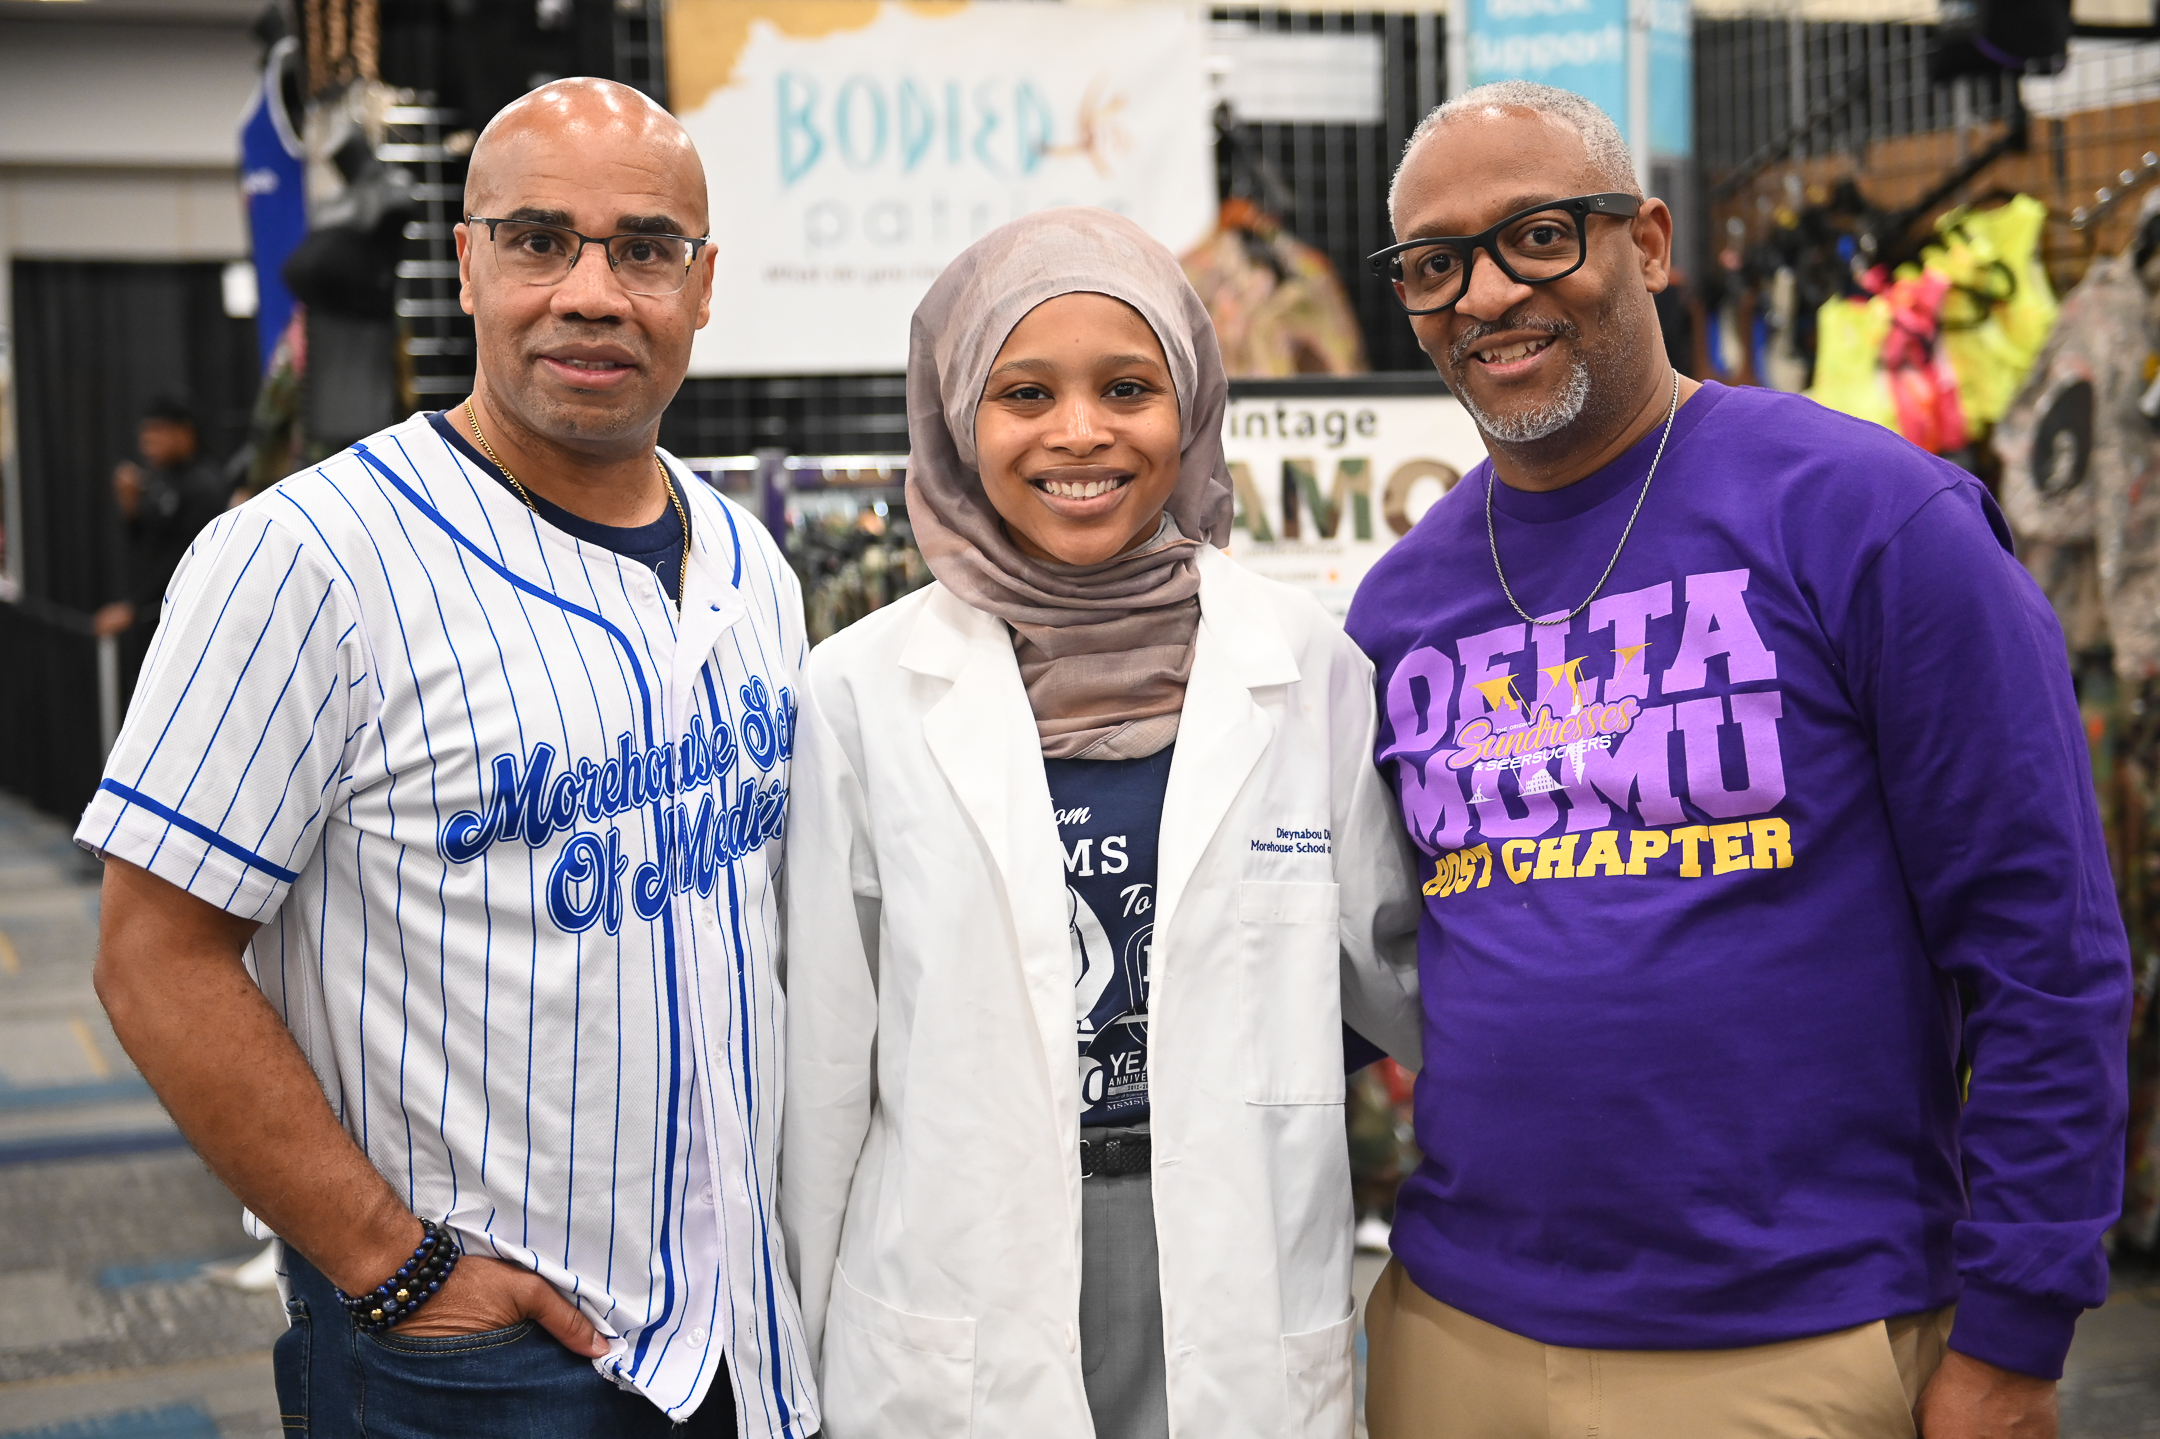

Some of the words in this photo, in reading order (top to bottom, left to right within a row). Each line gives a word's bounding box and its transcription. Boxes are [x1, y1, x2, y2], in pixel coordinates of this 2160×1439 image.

[776, 72, 1053, 190] BODIED
[1229, 399, 1379, 447] intage
[1380, 568, 1778, 762] DELTA
[1449, 698, 1641, 768] Sundresses
[441, 713, 738, 865] Morehouse
[1473, 762, 1484, 772] &
[1052, 798, 1092, 825] om
[1276, 827, 1322, 841] Dieynabou
[1250, 839, 1294, 853] Morehouse
[1295, 842, 1326, 853] School
[1501, 817, 1795, 885] CHAPTER
[546, 827, 629, 936] Of
[1119, 883, 1153, 918] To
